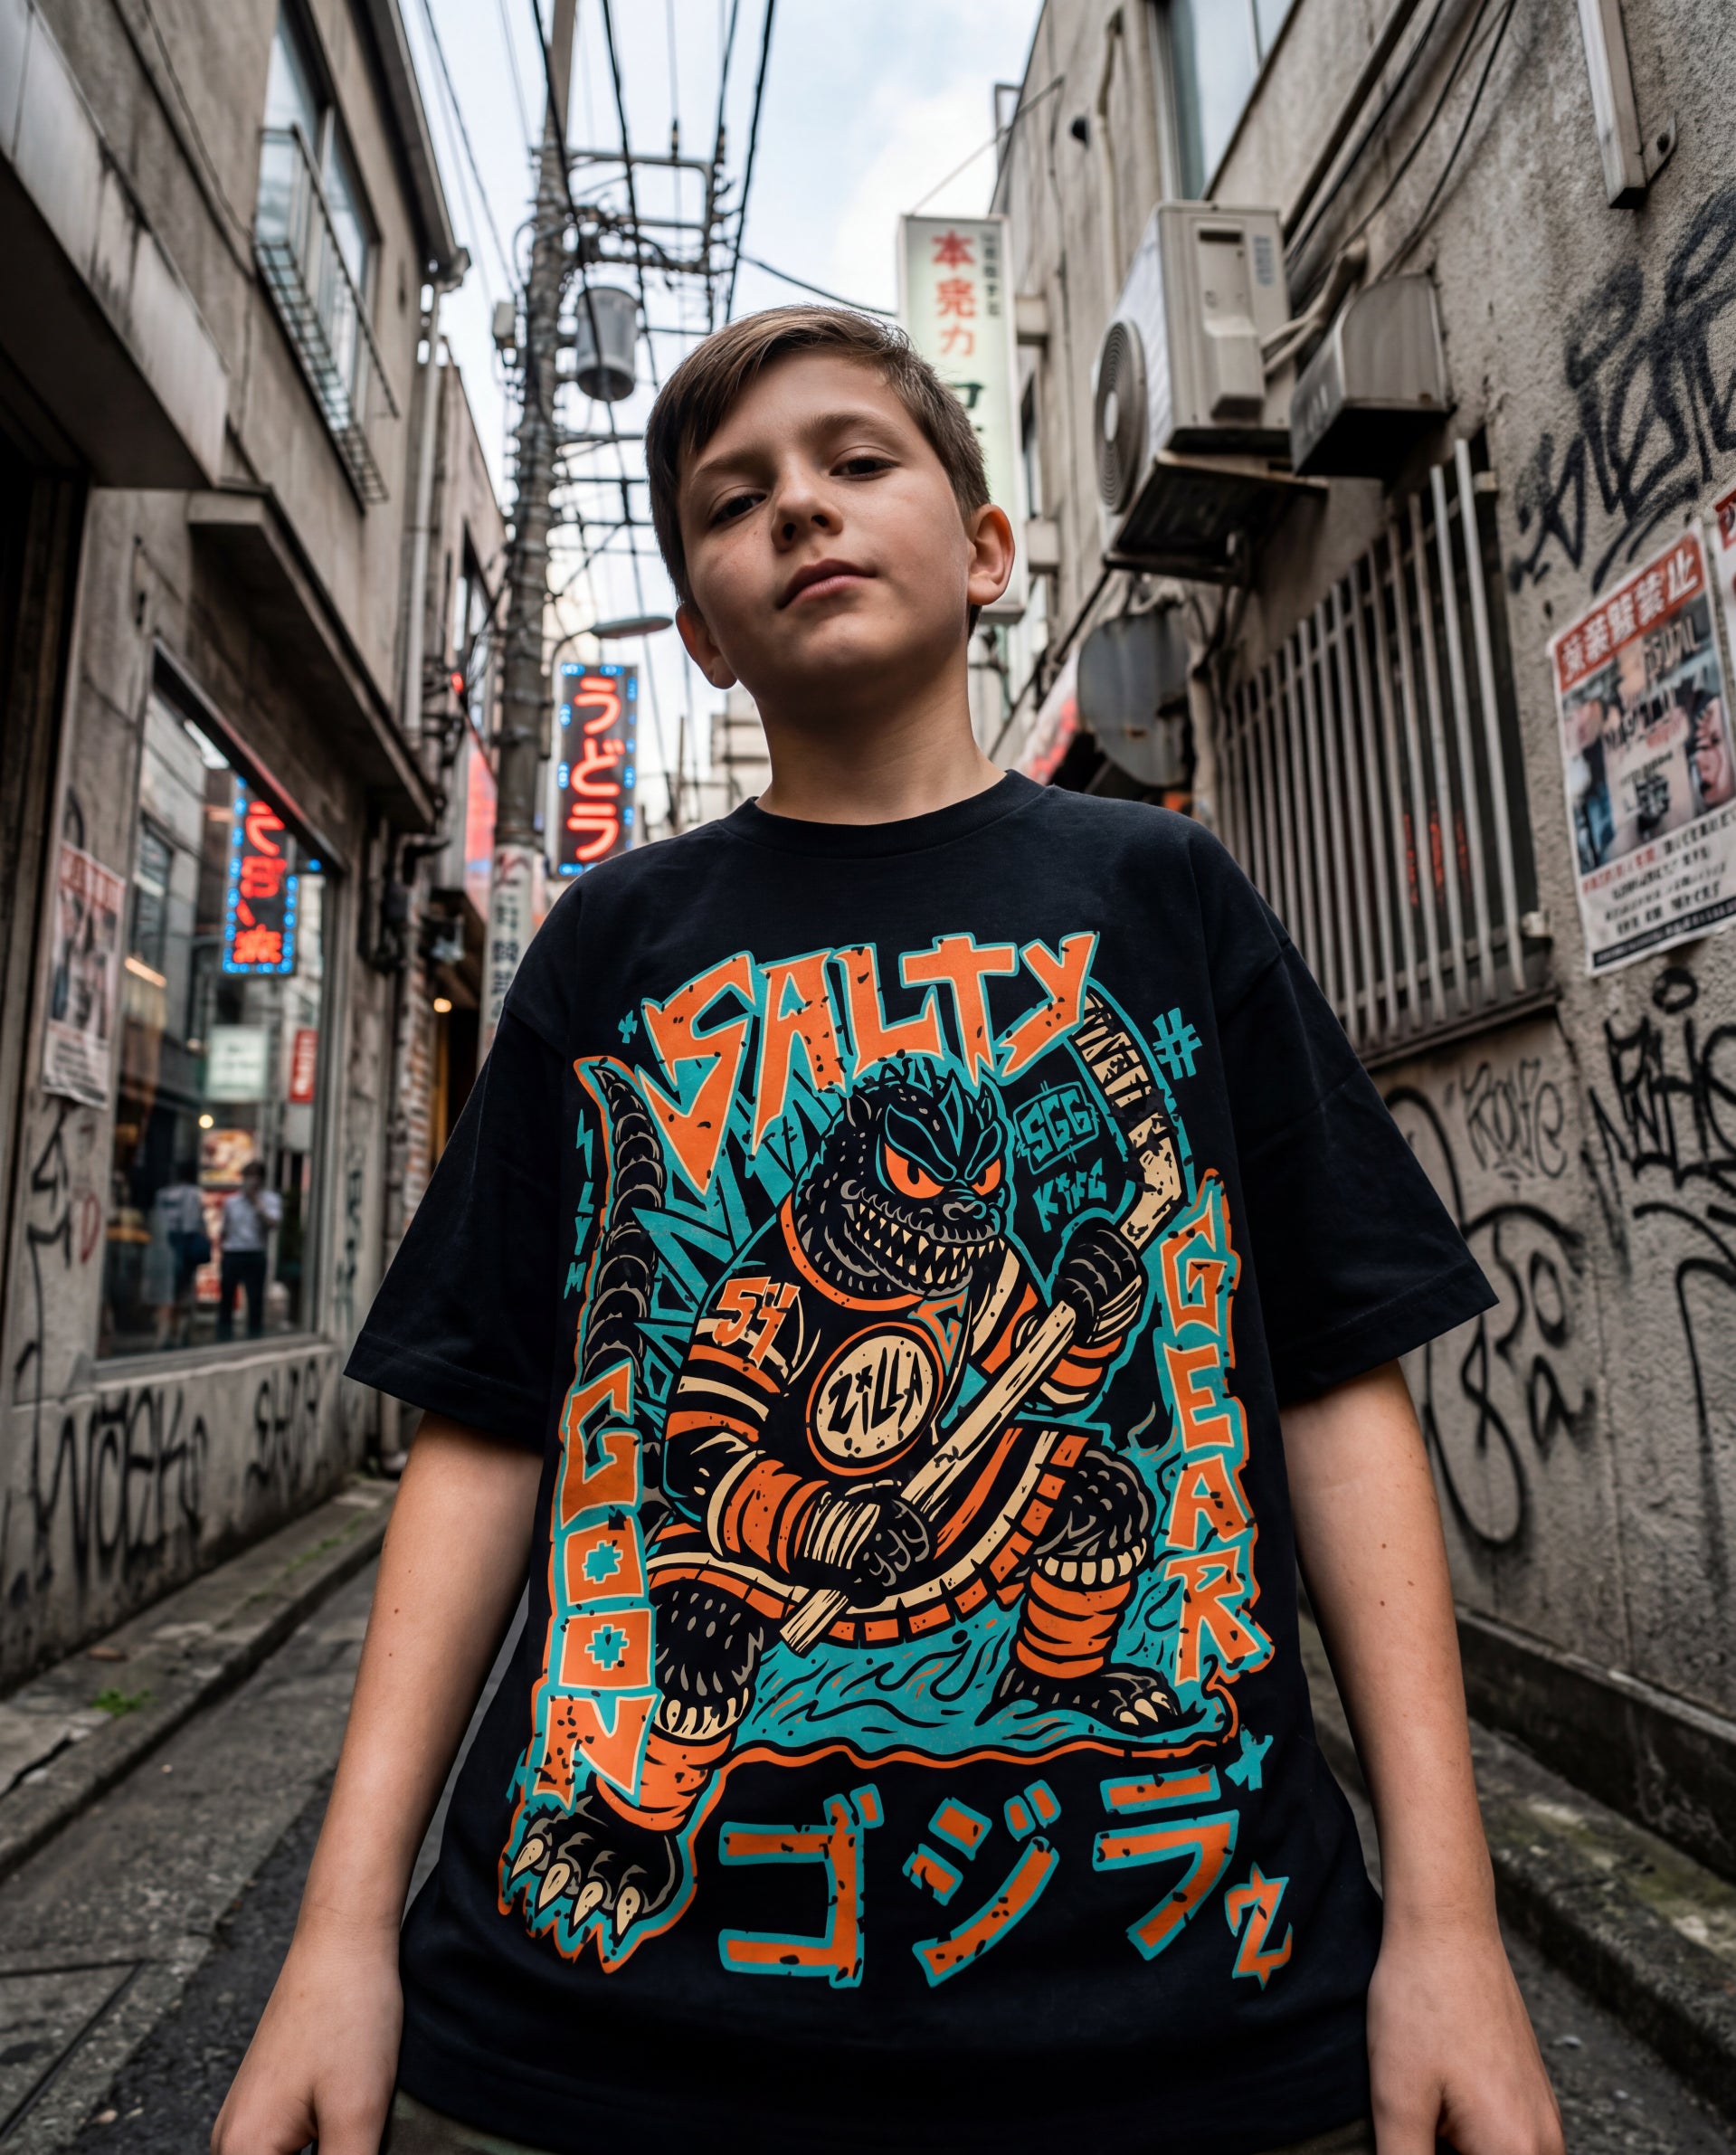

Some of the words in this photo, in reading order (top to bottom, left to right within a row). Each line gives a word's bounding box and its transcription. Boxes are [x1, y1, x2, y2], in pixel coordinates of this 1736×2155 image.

[636, 931, 1098, 1195] SALTY
[1020, 1089, 1093, 1163] SGG
[1160, 1192, 1266, 1685] GEAR
[532, 1361, 658, 1810] GOON
[719, 1766, 1239, 1989] ゴジラ
